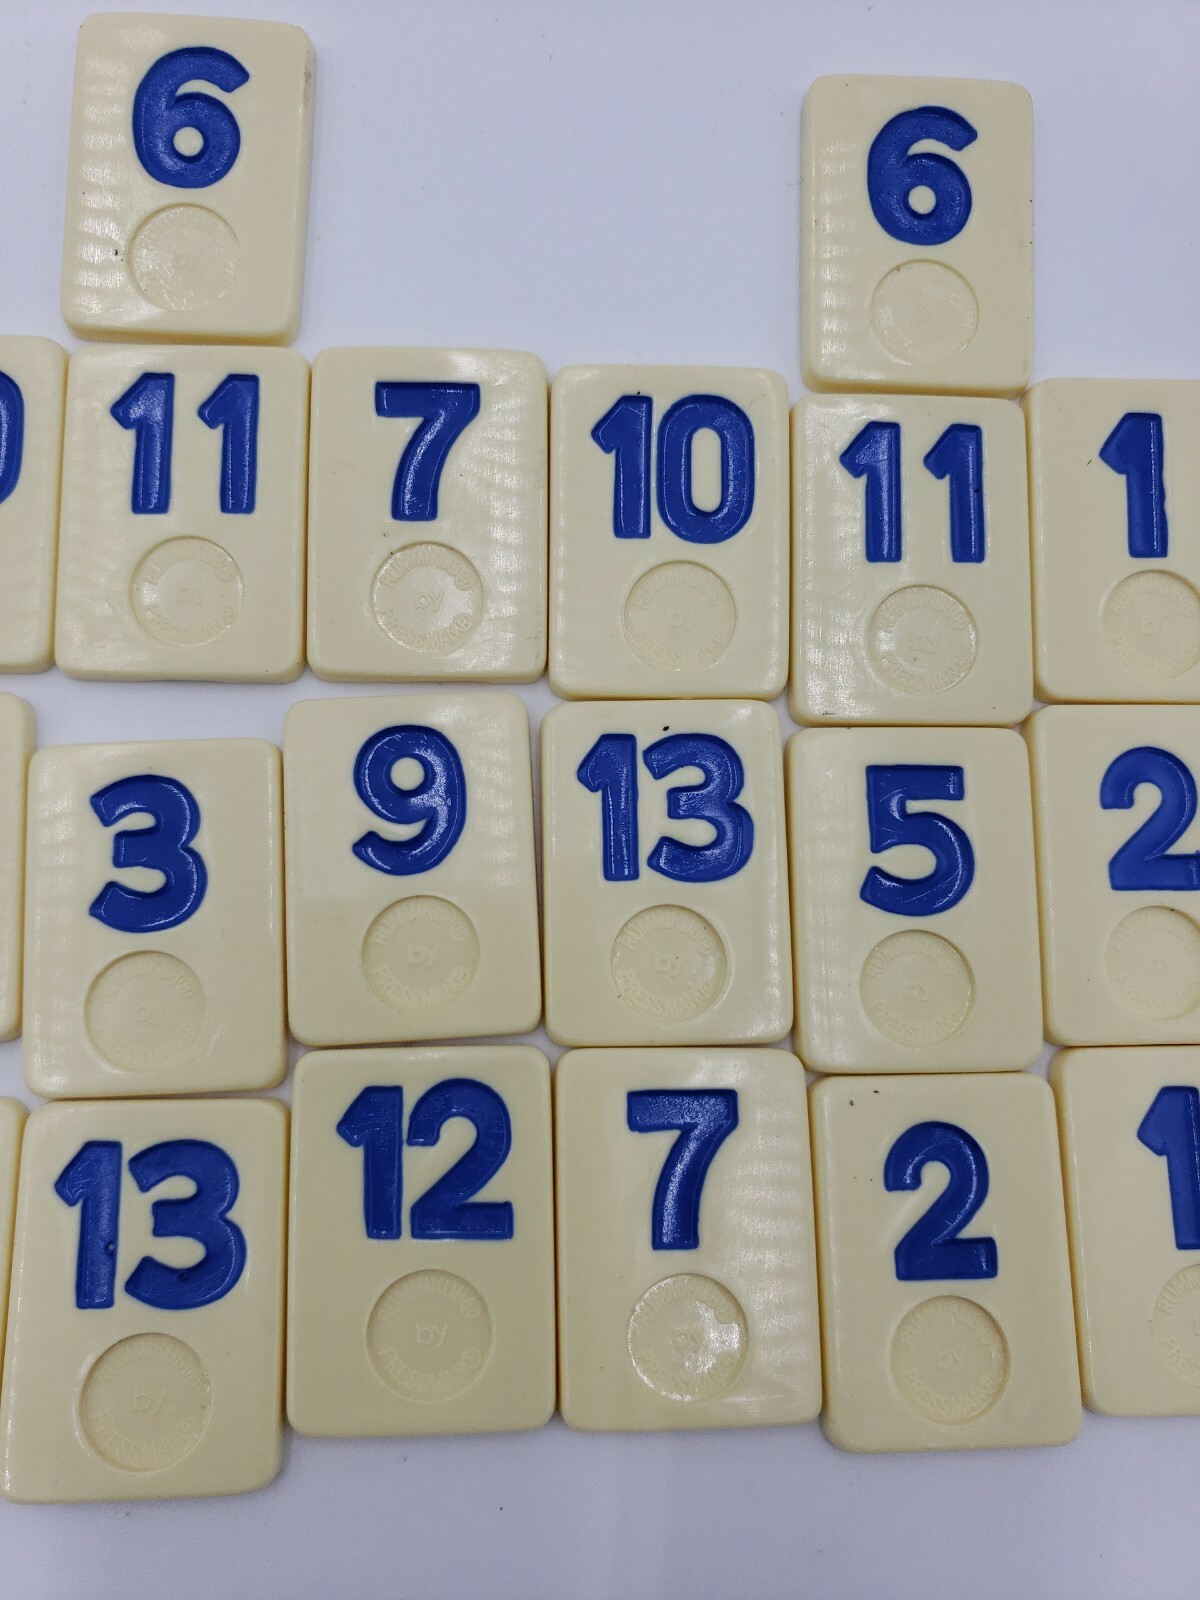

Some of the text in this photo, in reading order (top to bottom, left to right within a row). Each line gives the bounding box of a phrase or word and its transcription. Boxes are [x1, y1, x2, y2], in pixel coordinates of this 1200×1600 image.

[132, 46, 249, 188] 6
[867, 106, 977, 246] 6
[110, 373, 260, 515] 11
[375, 382, 480, 522] 7
[592, 394, 755, 544] 10
[839, 421, 986, 563] 11
[1099, 413, 1169, 558] 1
[89, 775, 207, 933] 3
[352, 725, 467, 876] 9
[577, 733, 754, 883] 13
[860, 765, 975, 917] 5
[1100, 746, 1200, 891] 2
[54, 1140, 246, 1310] 13
[336, 1079, 514, 1241] 12
[627, 1090, 738, 1250] 7
[884, 1122, 998, 1281] 2
[1137, 1086, 1200, 1250] 1
[134, 1389, 167, 1415] by
[416, 1322, 448, 1348] by
